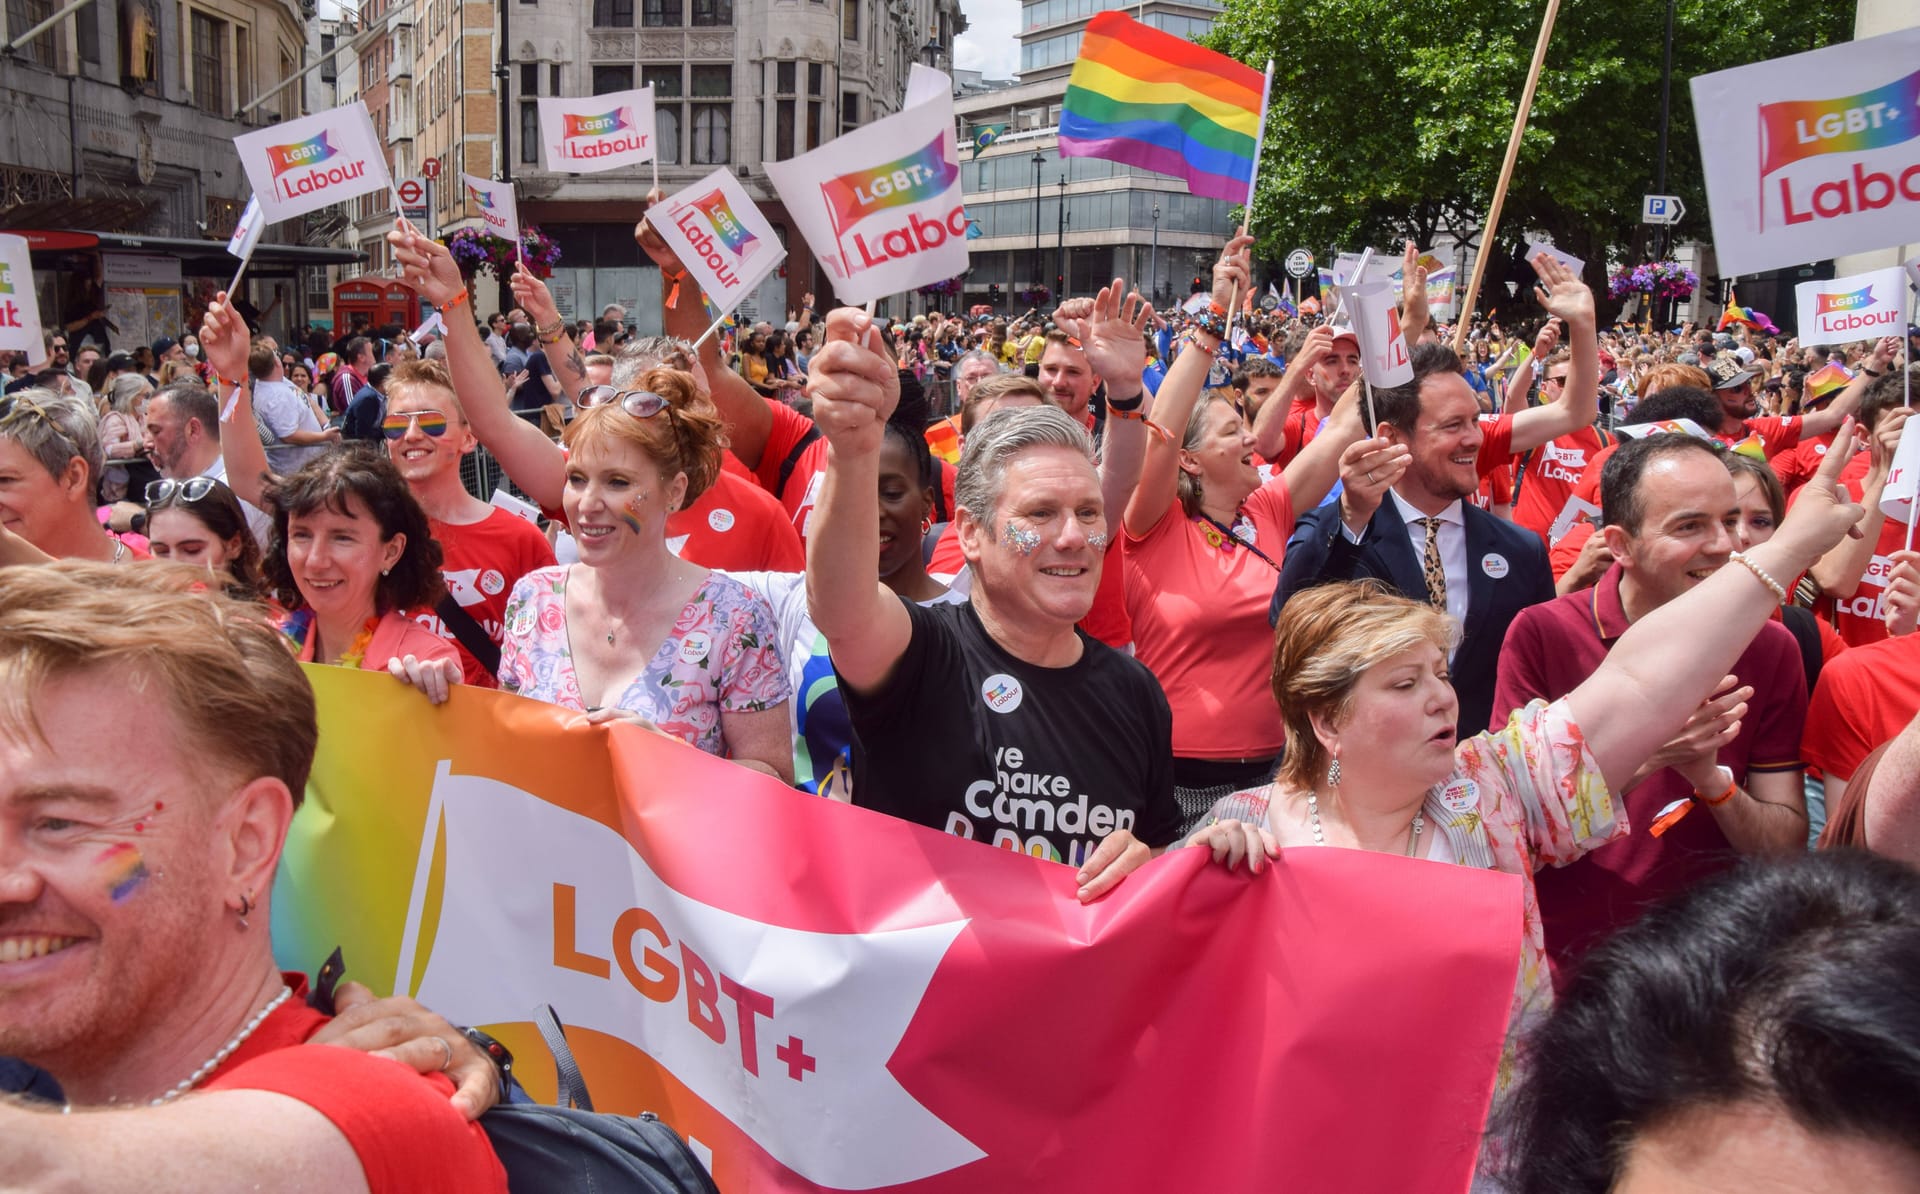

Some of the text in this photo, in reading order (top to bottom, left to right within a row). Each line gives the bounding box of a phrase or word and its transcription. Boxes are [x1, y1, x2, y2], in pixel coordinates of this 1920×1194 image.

[1796, 102, 1900, 144] LGBT+
[571, 134, 648, 158] Labour
[282, 160, 365, 198] Labour
[426, 162, 436, 175] T
[854, 164, 934, 205] LGBT+
[1652, 200, 1663, 213] P
[709, 204, 739, 240] LGBT+
[676, 210, 740, 288] Labour
[1829, 294, 1864, 308] LGBT+
[1822, 310, 1899, 332] Labour
[994, 687, 1018, 707] Labour
[552, 882, 816, 1082] LGBT+
